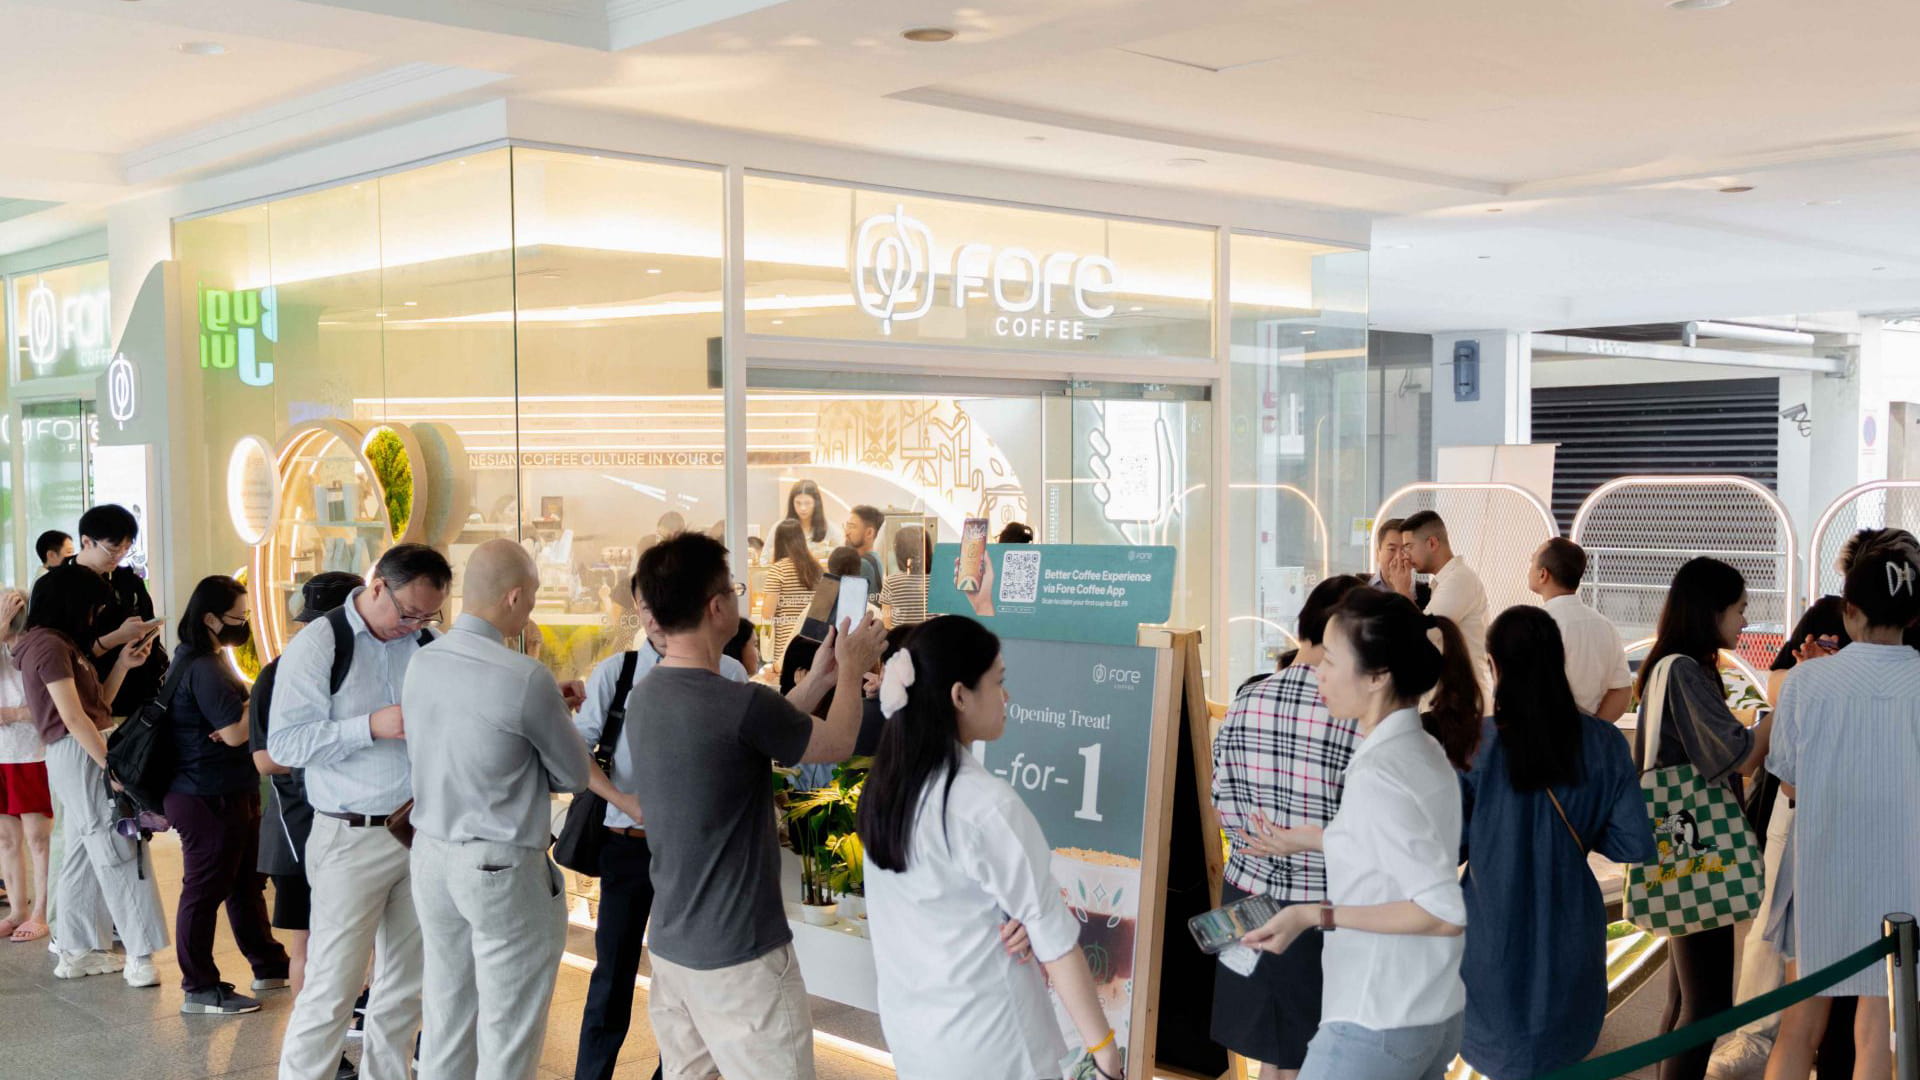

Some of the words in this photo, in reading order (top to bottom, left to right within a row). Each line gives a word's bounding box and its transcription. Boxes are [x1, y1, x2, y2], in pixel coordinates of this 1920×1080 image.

[995, 316, 1084, 340] COFFEE
[523, 453, 578, 465] COFFEE
[581, 453, 644, 465] CULTURE
[648, 453, 663, 465] IN
[666, 453, 709, 465] YOUR
[1044, 569, 1072, 580] Better
[1072, 569, 1101, 581] Coffee
[1102, 570, 1152, 583] Experience
[1043, 583, 1056, 593] via
[1056, 583, 1076, 594] Fore
[1076, 584, 1106, 595] Coffee
[1106, 585, 1126, 597] App
[1109, 669, 1141, 684] Fore
[1009, 703, 1066, 728] Opening
[1069, 709, 1111, 730] Treat!
[972, 740, 1103, 822] -for-1
